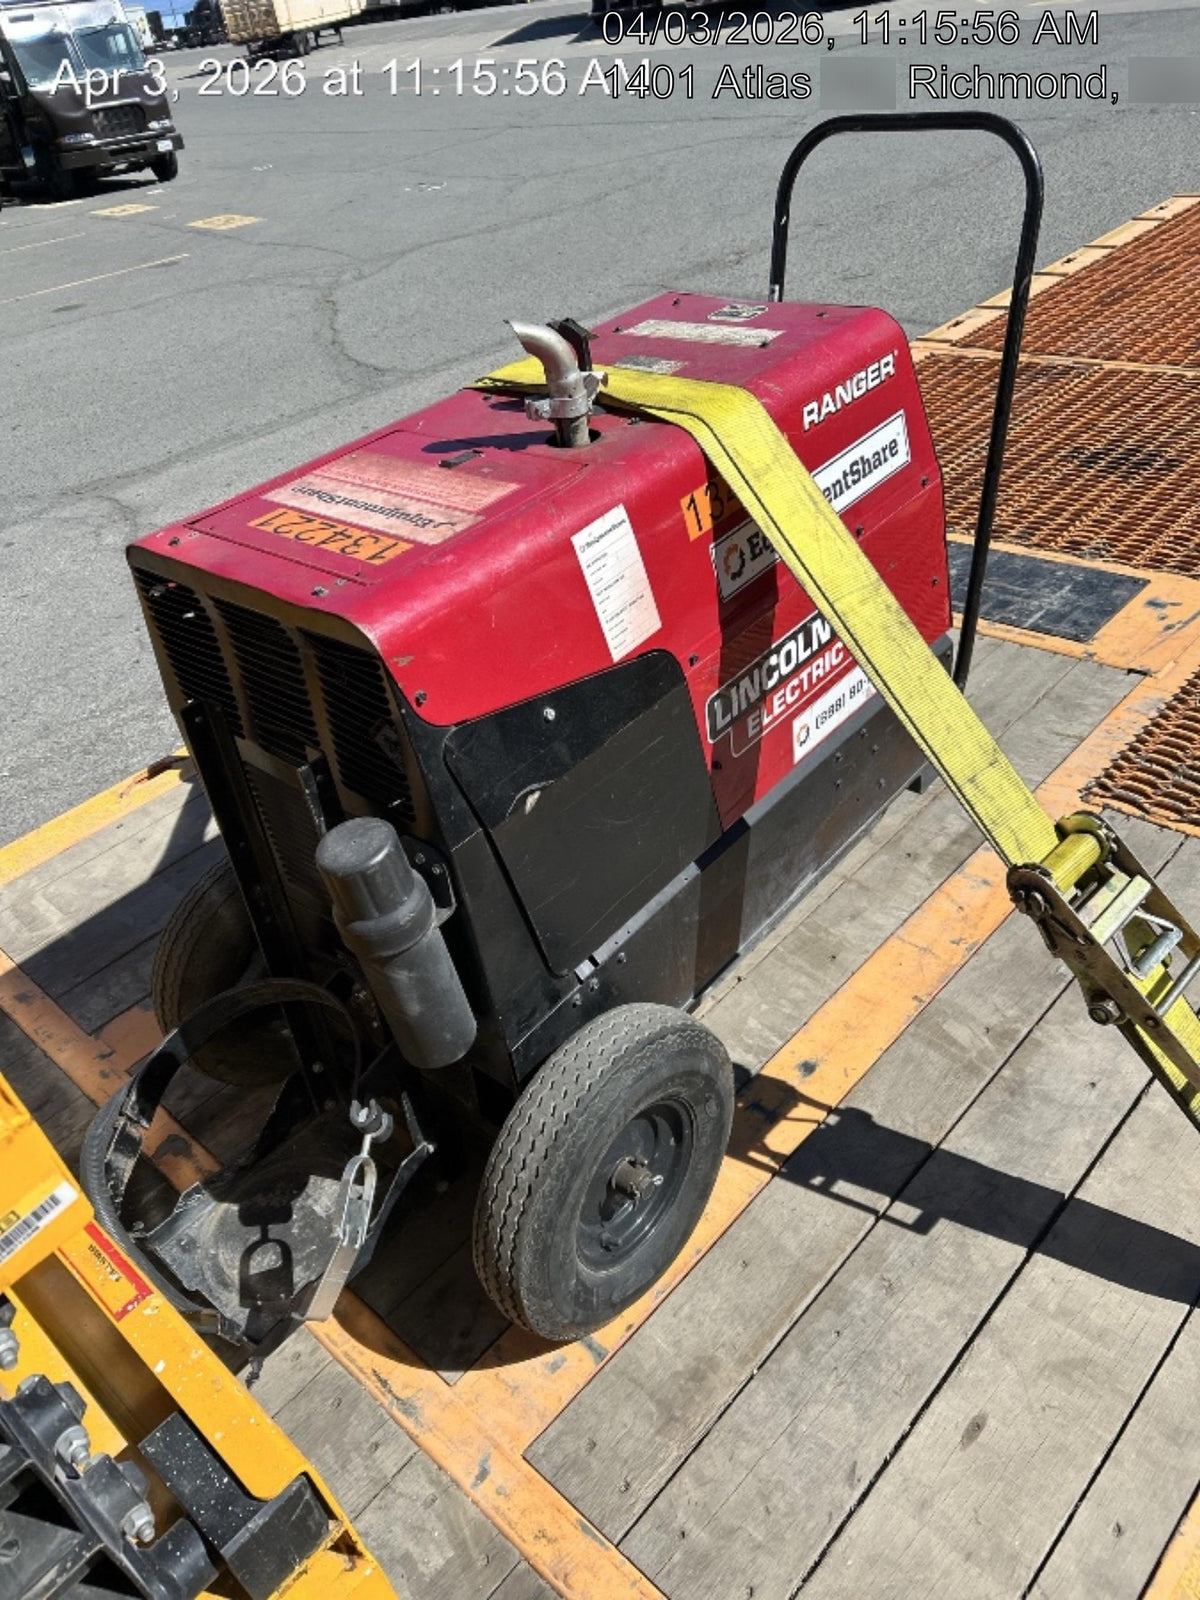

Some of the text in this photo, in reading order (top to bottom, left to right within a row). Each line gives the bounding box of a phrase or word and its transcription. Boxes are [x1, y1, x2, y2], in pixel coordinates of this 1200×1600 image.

[255, 511, 400, 561] 134221
[714, 617, 832, 732] LINCOLN
[746, 640, 845, 739] ELECTRIC
